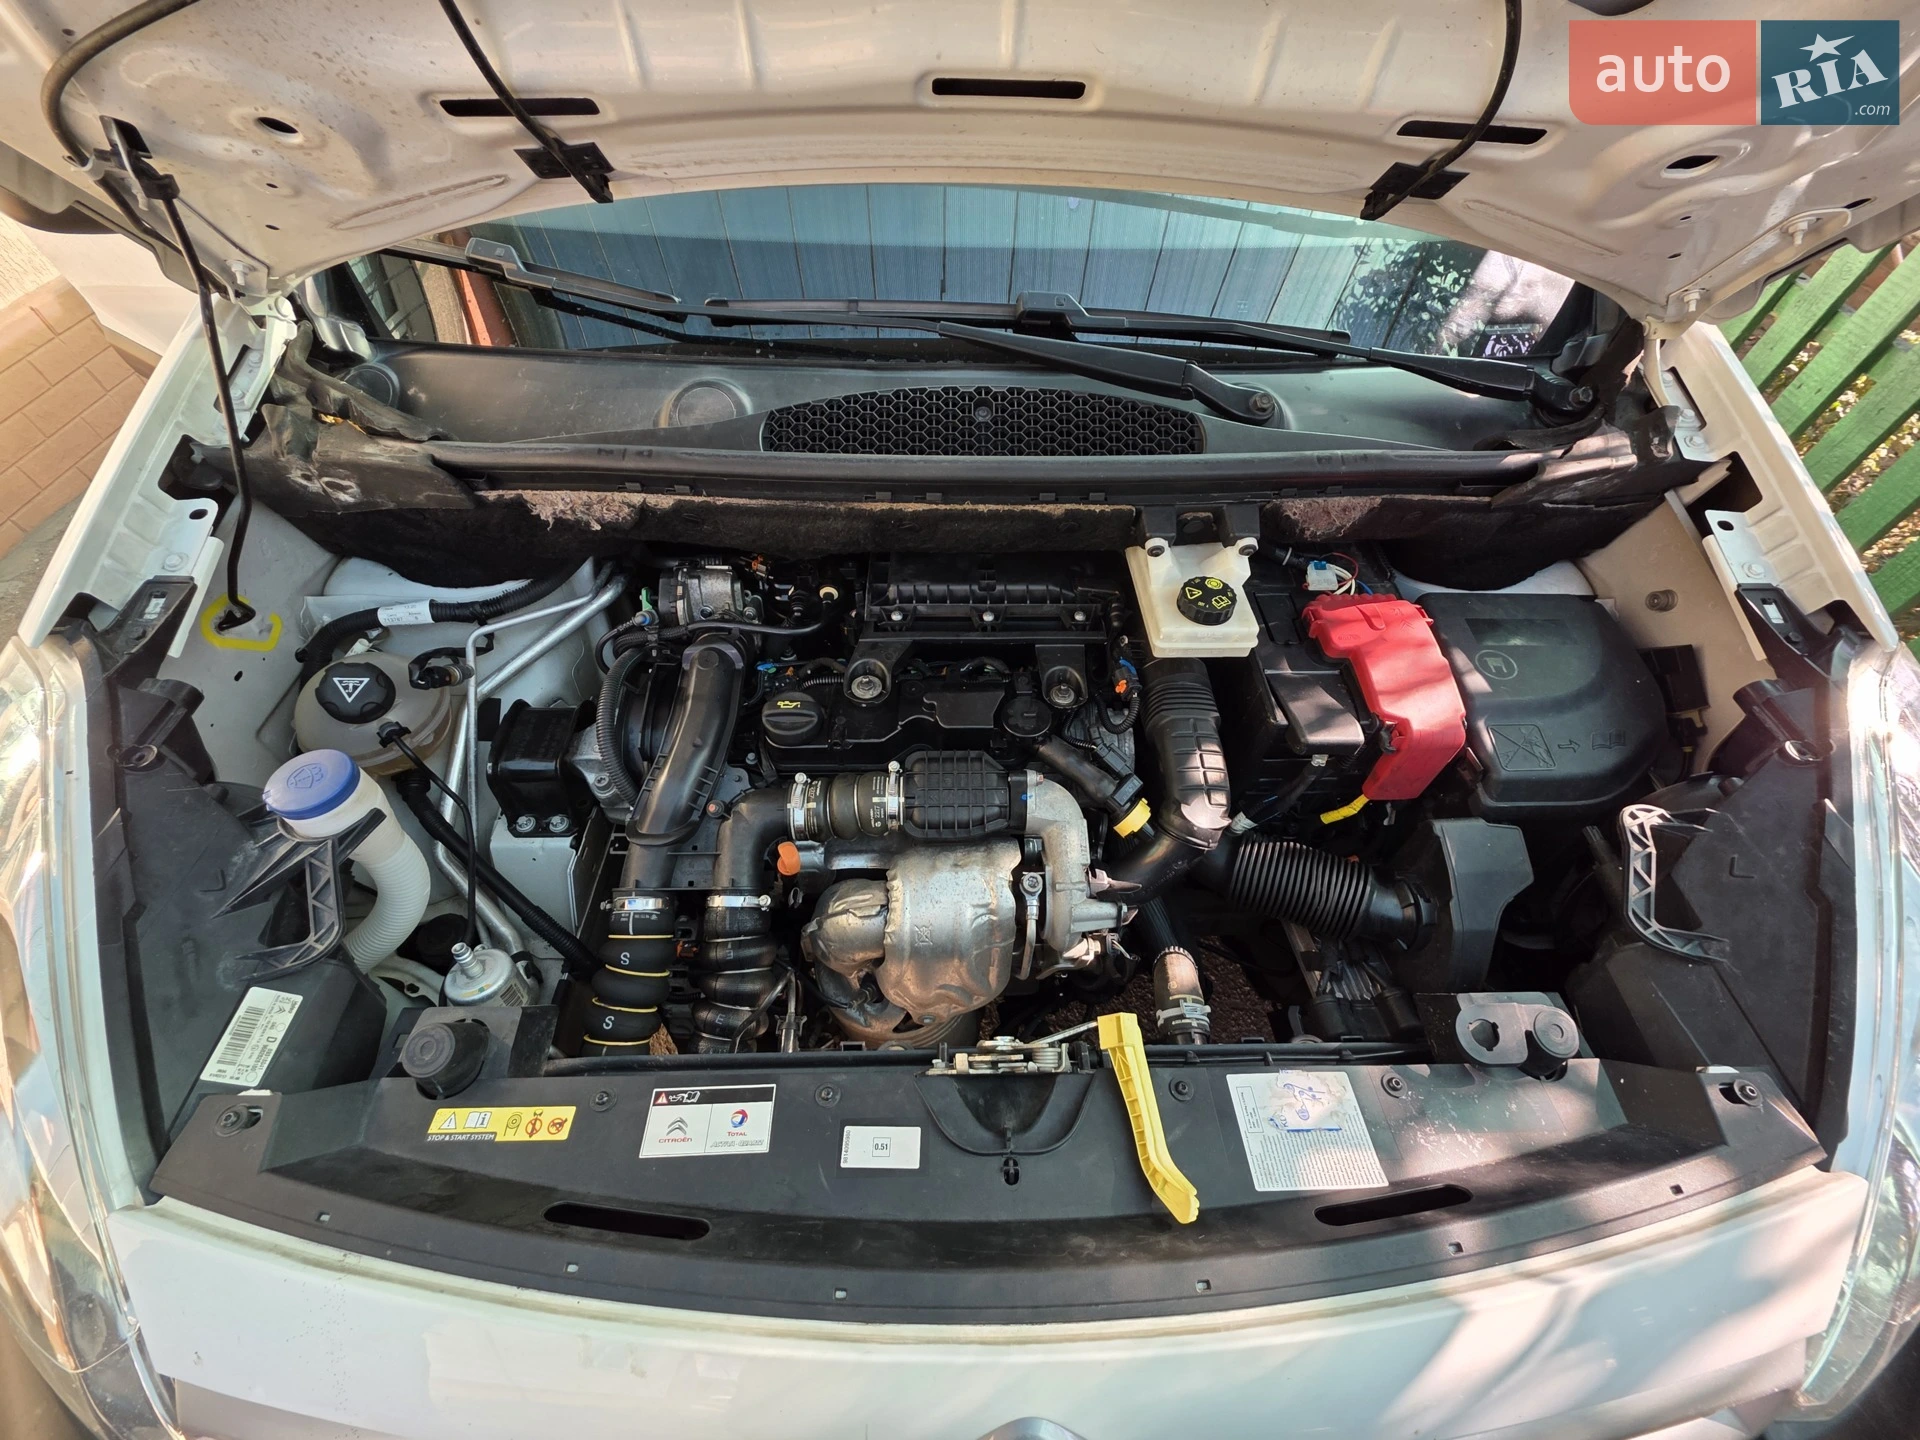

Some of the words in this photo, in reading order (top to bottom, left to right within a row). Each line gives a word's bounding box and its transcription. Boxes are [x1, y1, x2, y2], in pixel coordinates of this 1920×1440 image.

[620, 951, 630, 966] S
[602, 1015, 615, 1030] S
[874, 1142, 888, 1151] 0.51
